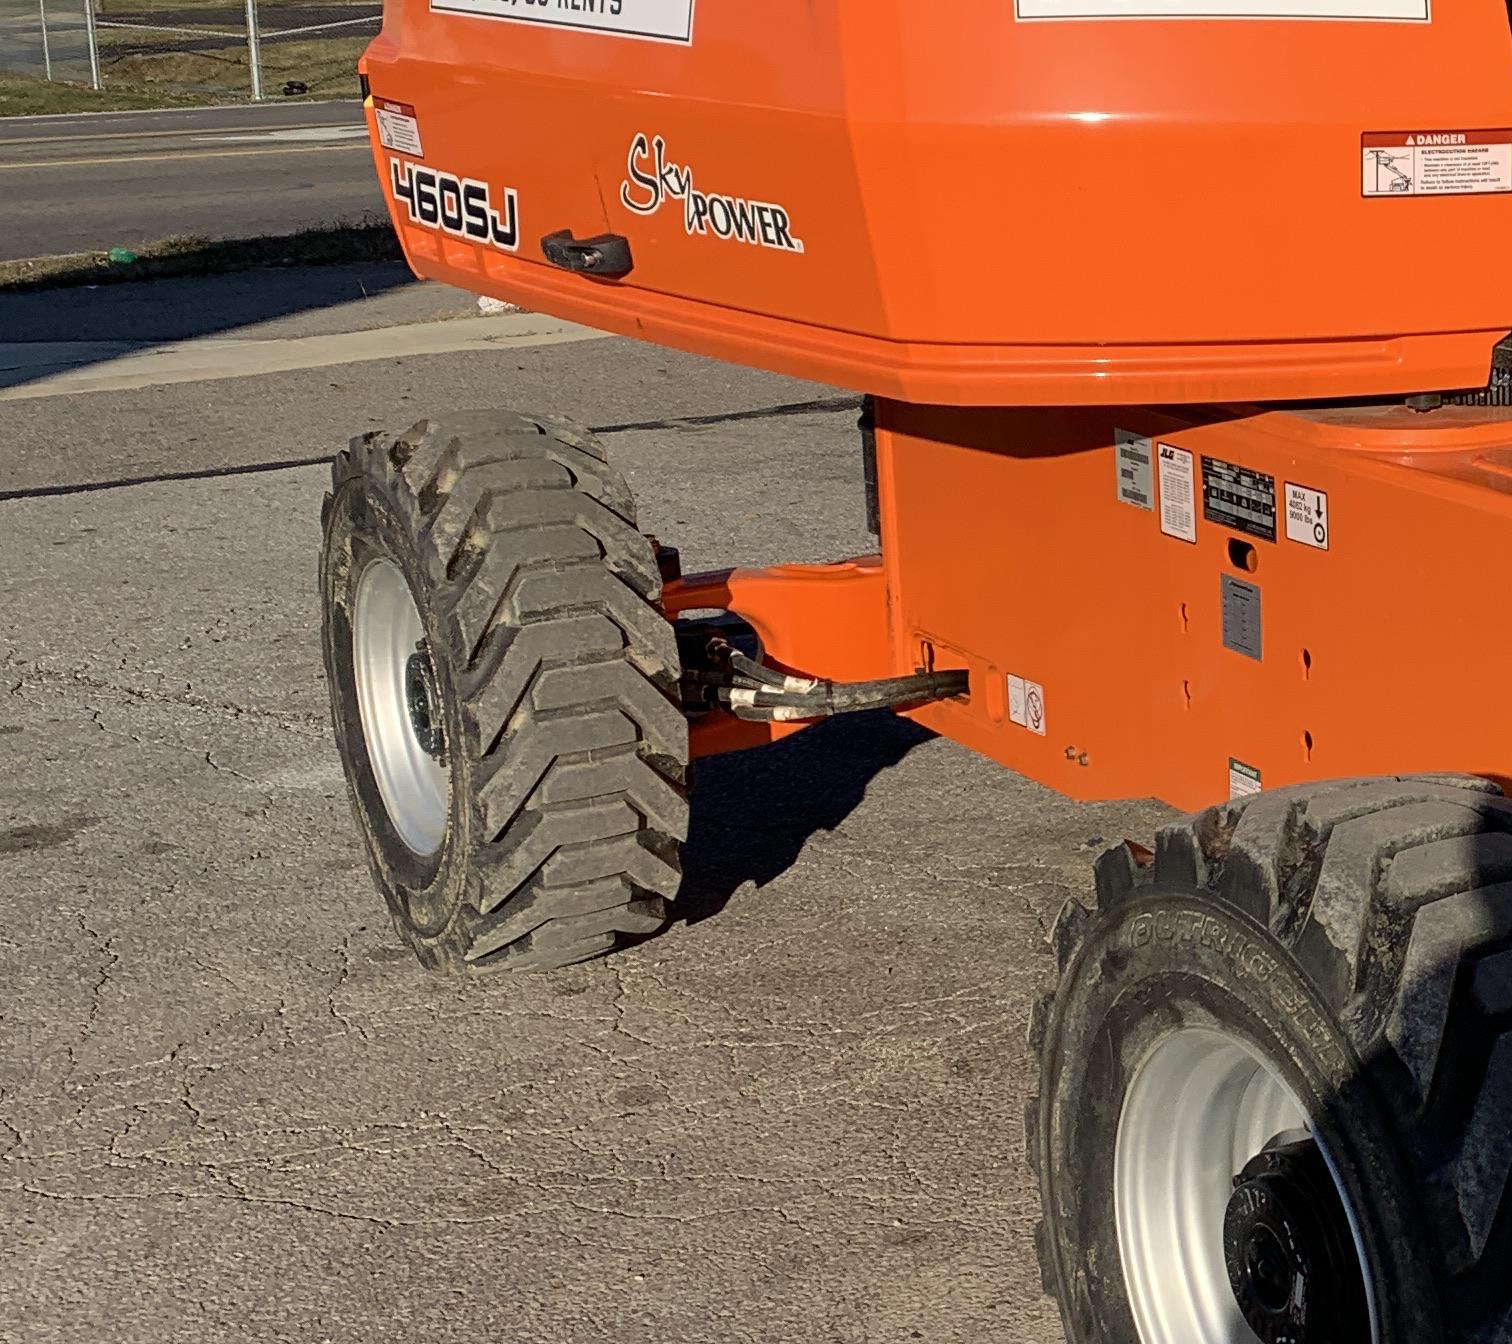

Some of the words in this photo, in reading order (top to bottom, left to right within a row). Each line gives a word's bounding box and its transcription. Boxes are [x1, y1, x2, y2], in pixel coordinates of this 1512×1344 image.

[1417, 133, 1466, 145] DANGER
[621, 134, 696, 232] Sky
[392, 160, 517, 248] 460SJ
[691, 193, 796, 249] POWER
[1160, 447, 1175, 460] JLG
[1292, 490, 1305, 501] MAX
